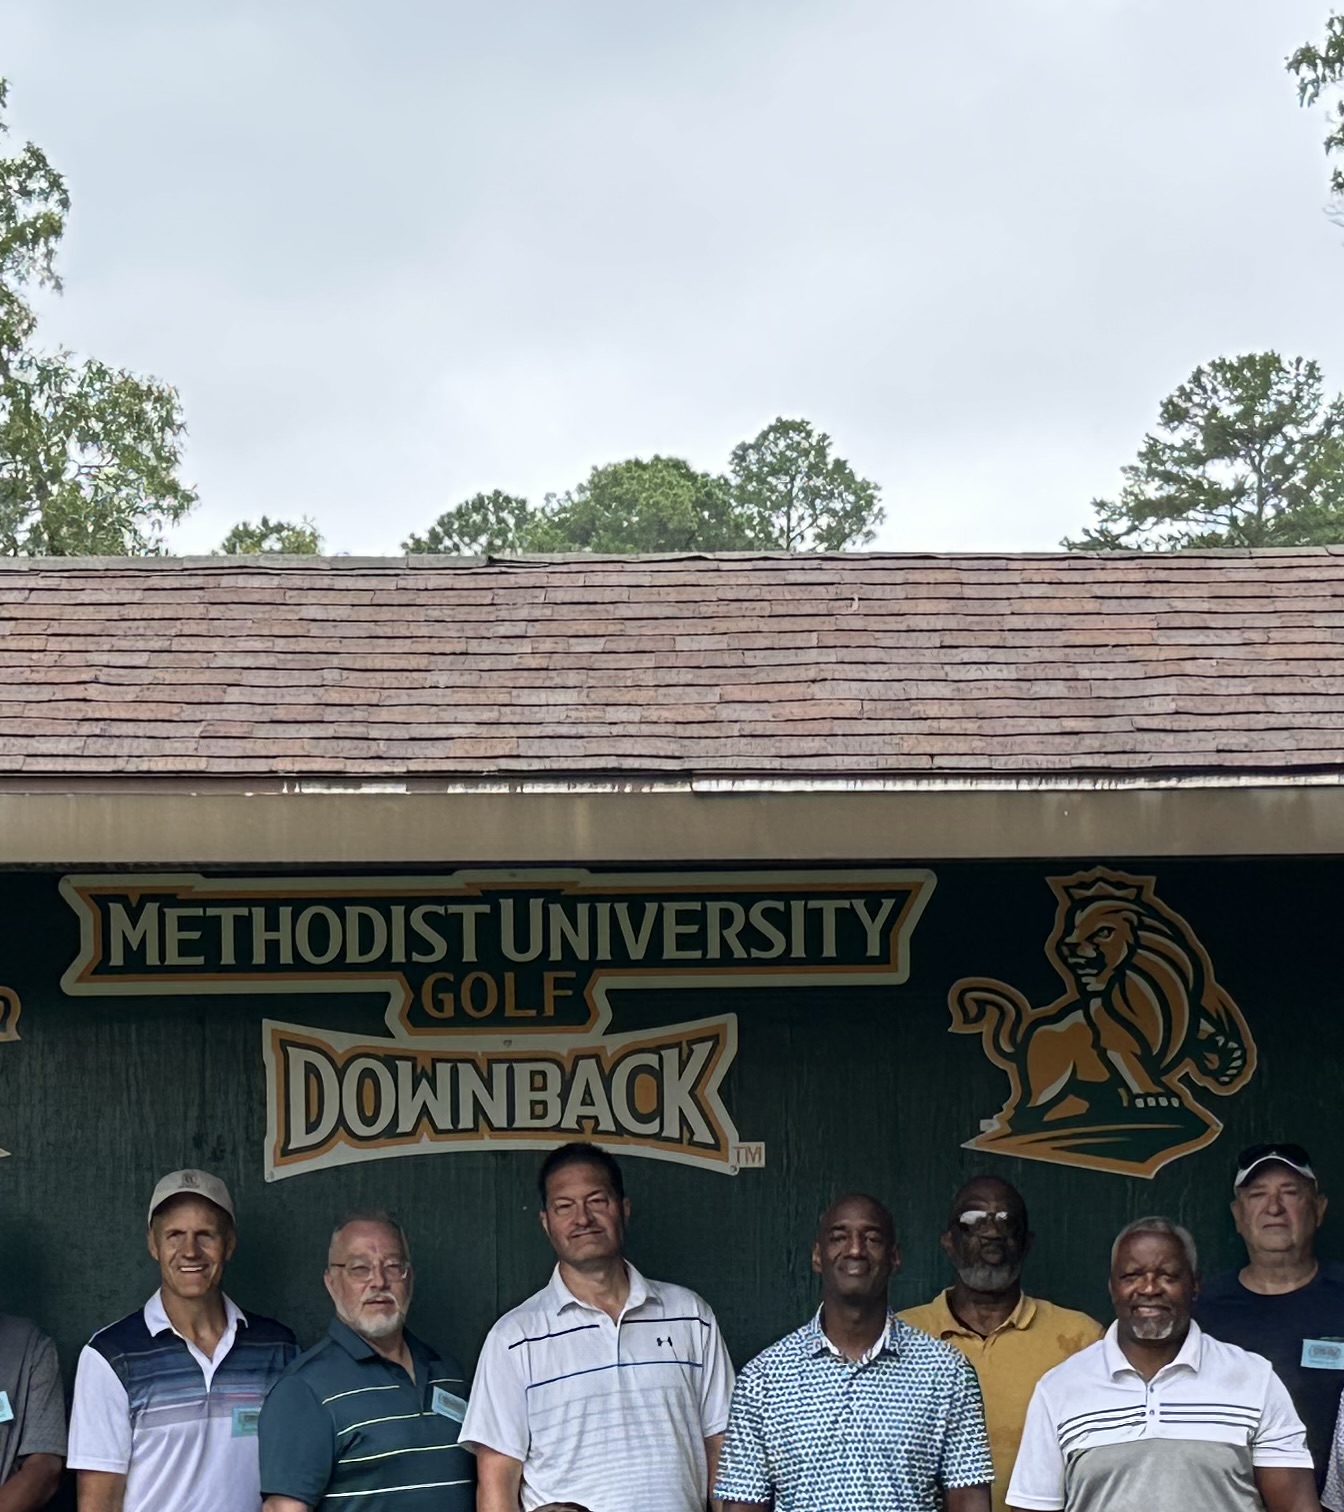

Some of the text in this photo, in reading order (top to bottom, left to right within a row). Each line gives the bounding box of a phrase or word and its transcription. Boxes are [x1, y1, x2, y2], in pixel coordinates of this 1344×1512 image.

[109, 897, 896, 967] METHODIST UNIVERSITY
[421, 970, 577, 1019] GOLF
[286, 1040, 716, 1150] DOWNBACK
[735, 1146, 764, 1164] TM
